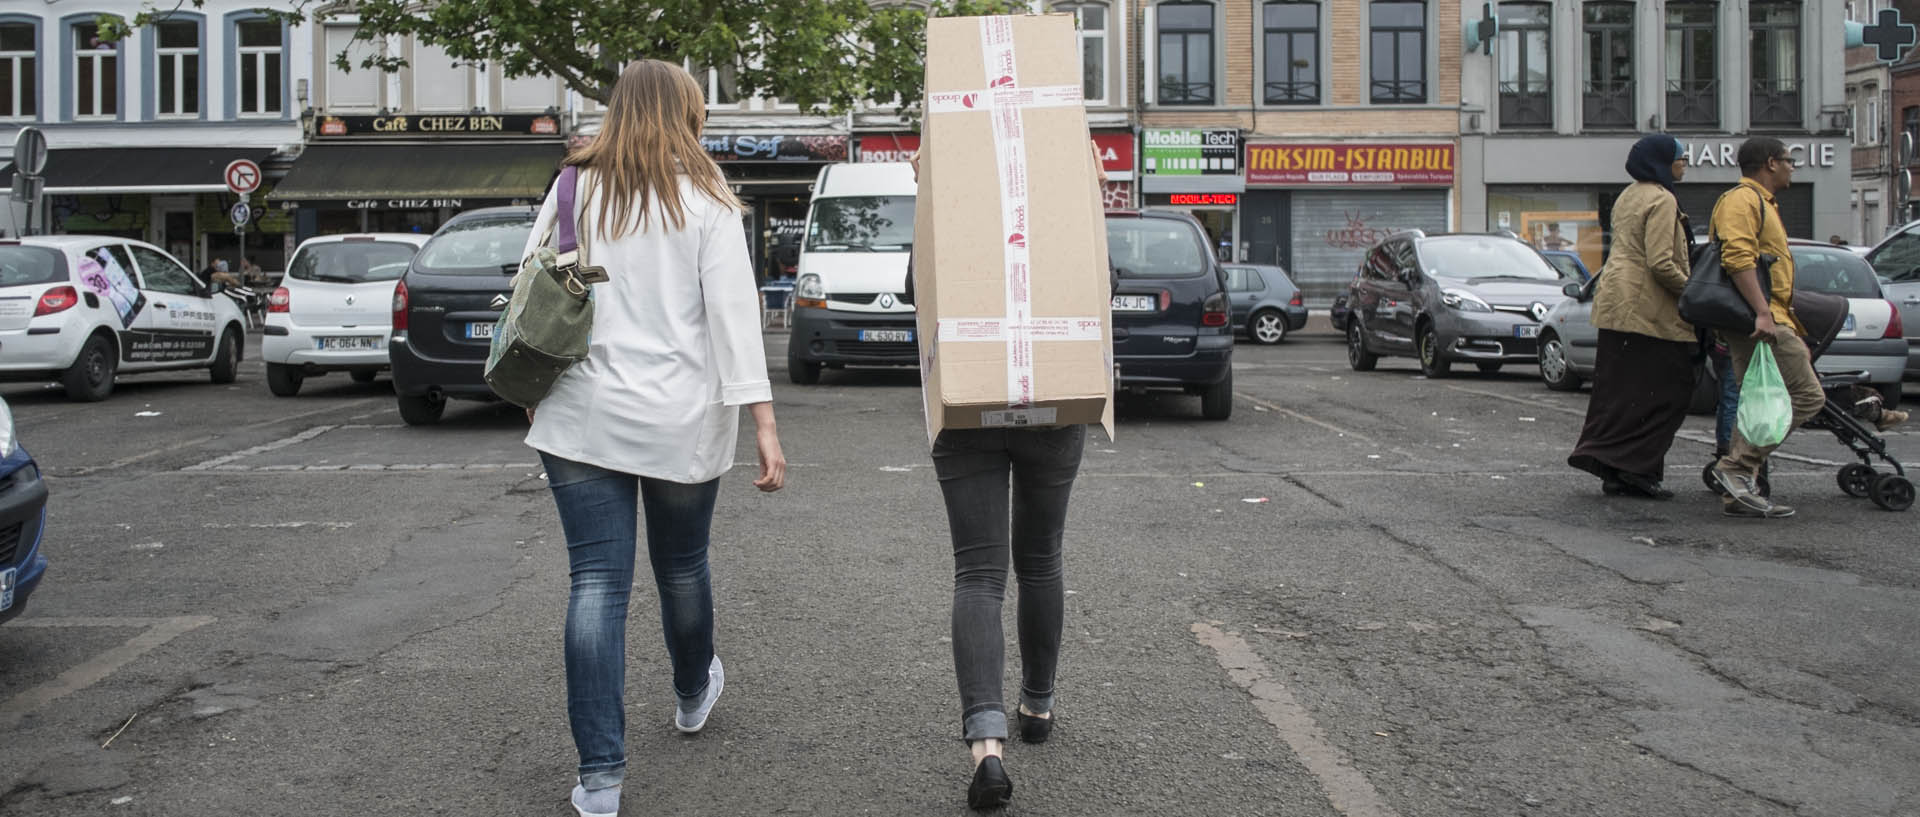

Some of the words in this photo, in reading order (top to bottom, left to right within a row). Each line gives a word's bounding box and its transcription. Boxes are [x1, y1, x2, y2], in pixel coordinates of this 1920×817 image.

[373, 117, 408, 131] Café
[419, 117, 465, 131] CHEZ
[470, 117, 504, 131] BEN
[1145, 130, 1201, 145] Mobile
[1203, 131, 1235, 145] Tech
[734, 135, 784, 158] Saf
[1250, 148, 1454, 170] TAKSIM-ISTANBUL
[347, 199, 378, 209] Café
[388, 199, 428, 208] CHEZ
[433, 199, 462, 208] BEN
